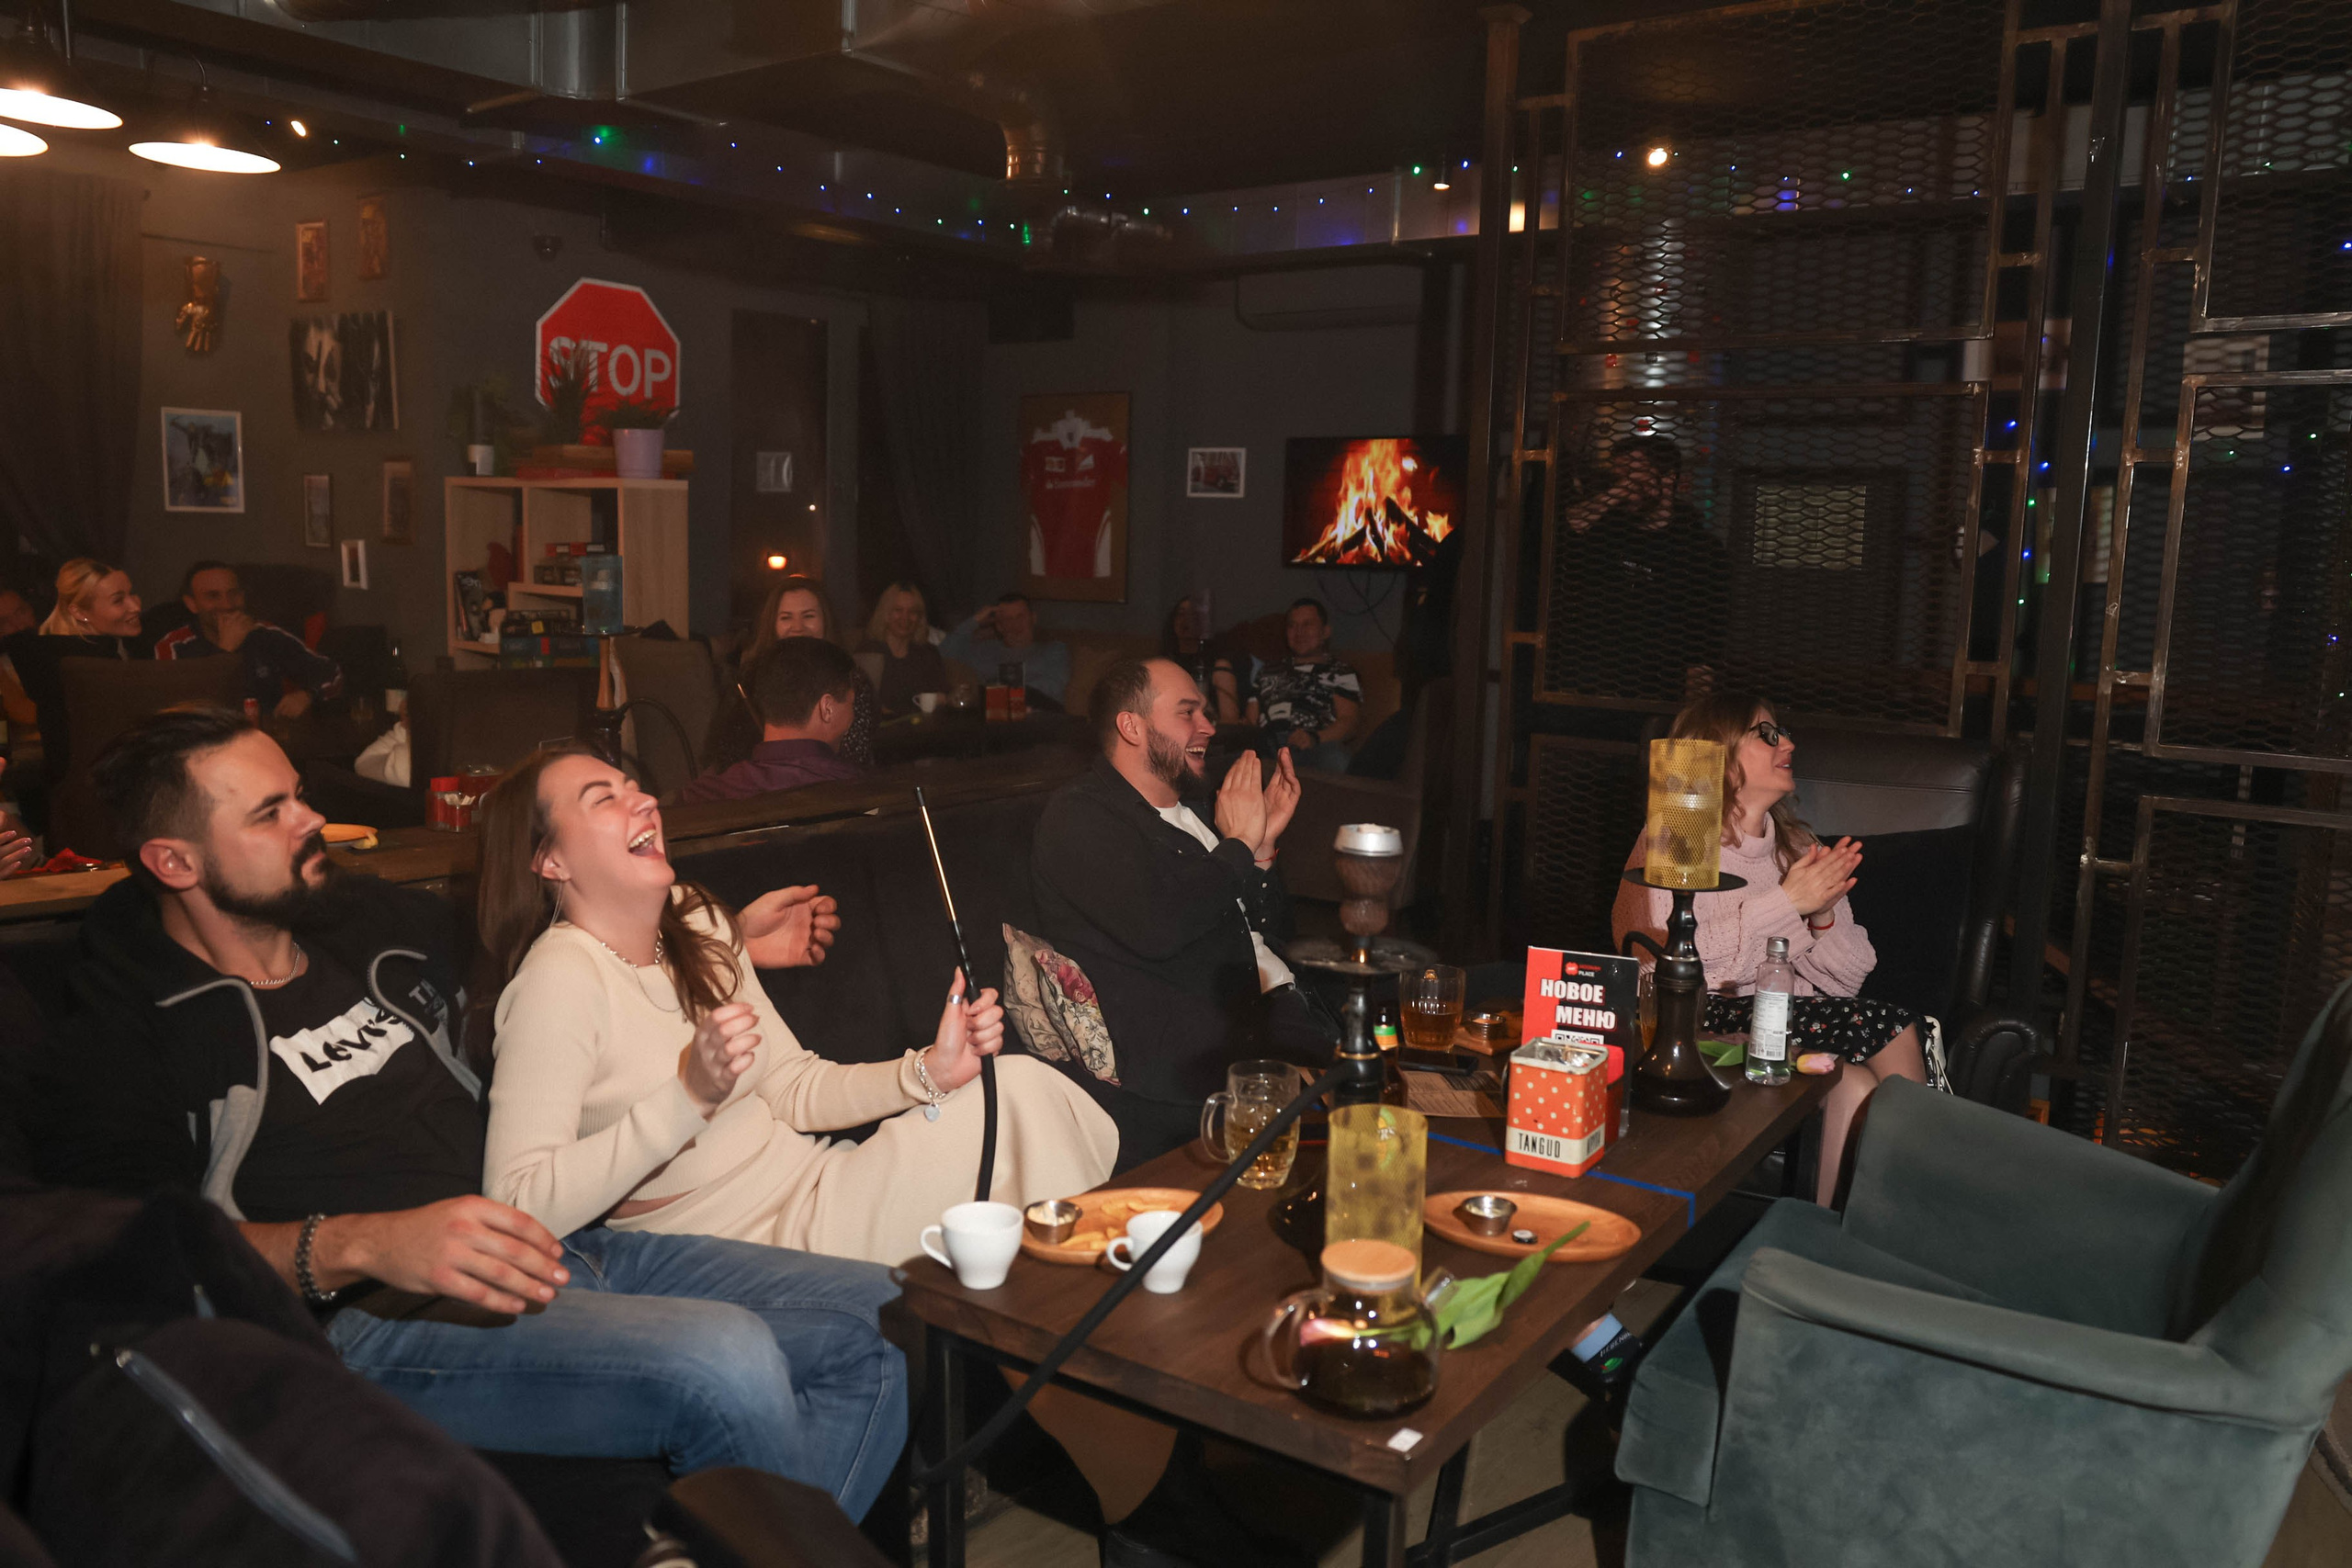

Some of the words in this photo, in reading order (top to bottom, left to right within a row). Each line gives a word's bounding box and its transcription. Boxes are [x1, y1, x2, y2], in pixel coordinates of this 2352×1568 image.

[548, 336, 673, 399] STOP
[1540, 978, 1605, 1005] НОВОЕ
[1555, 1005, 1617, 1030] МЕНЮ
